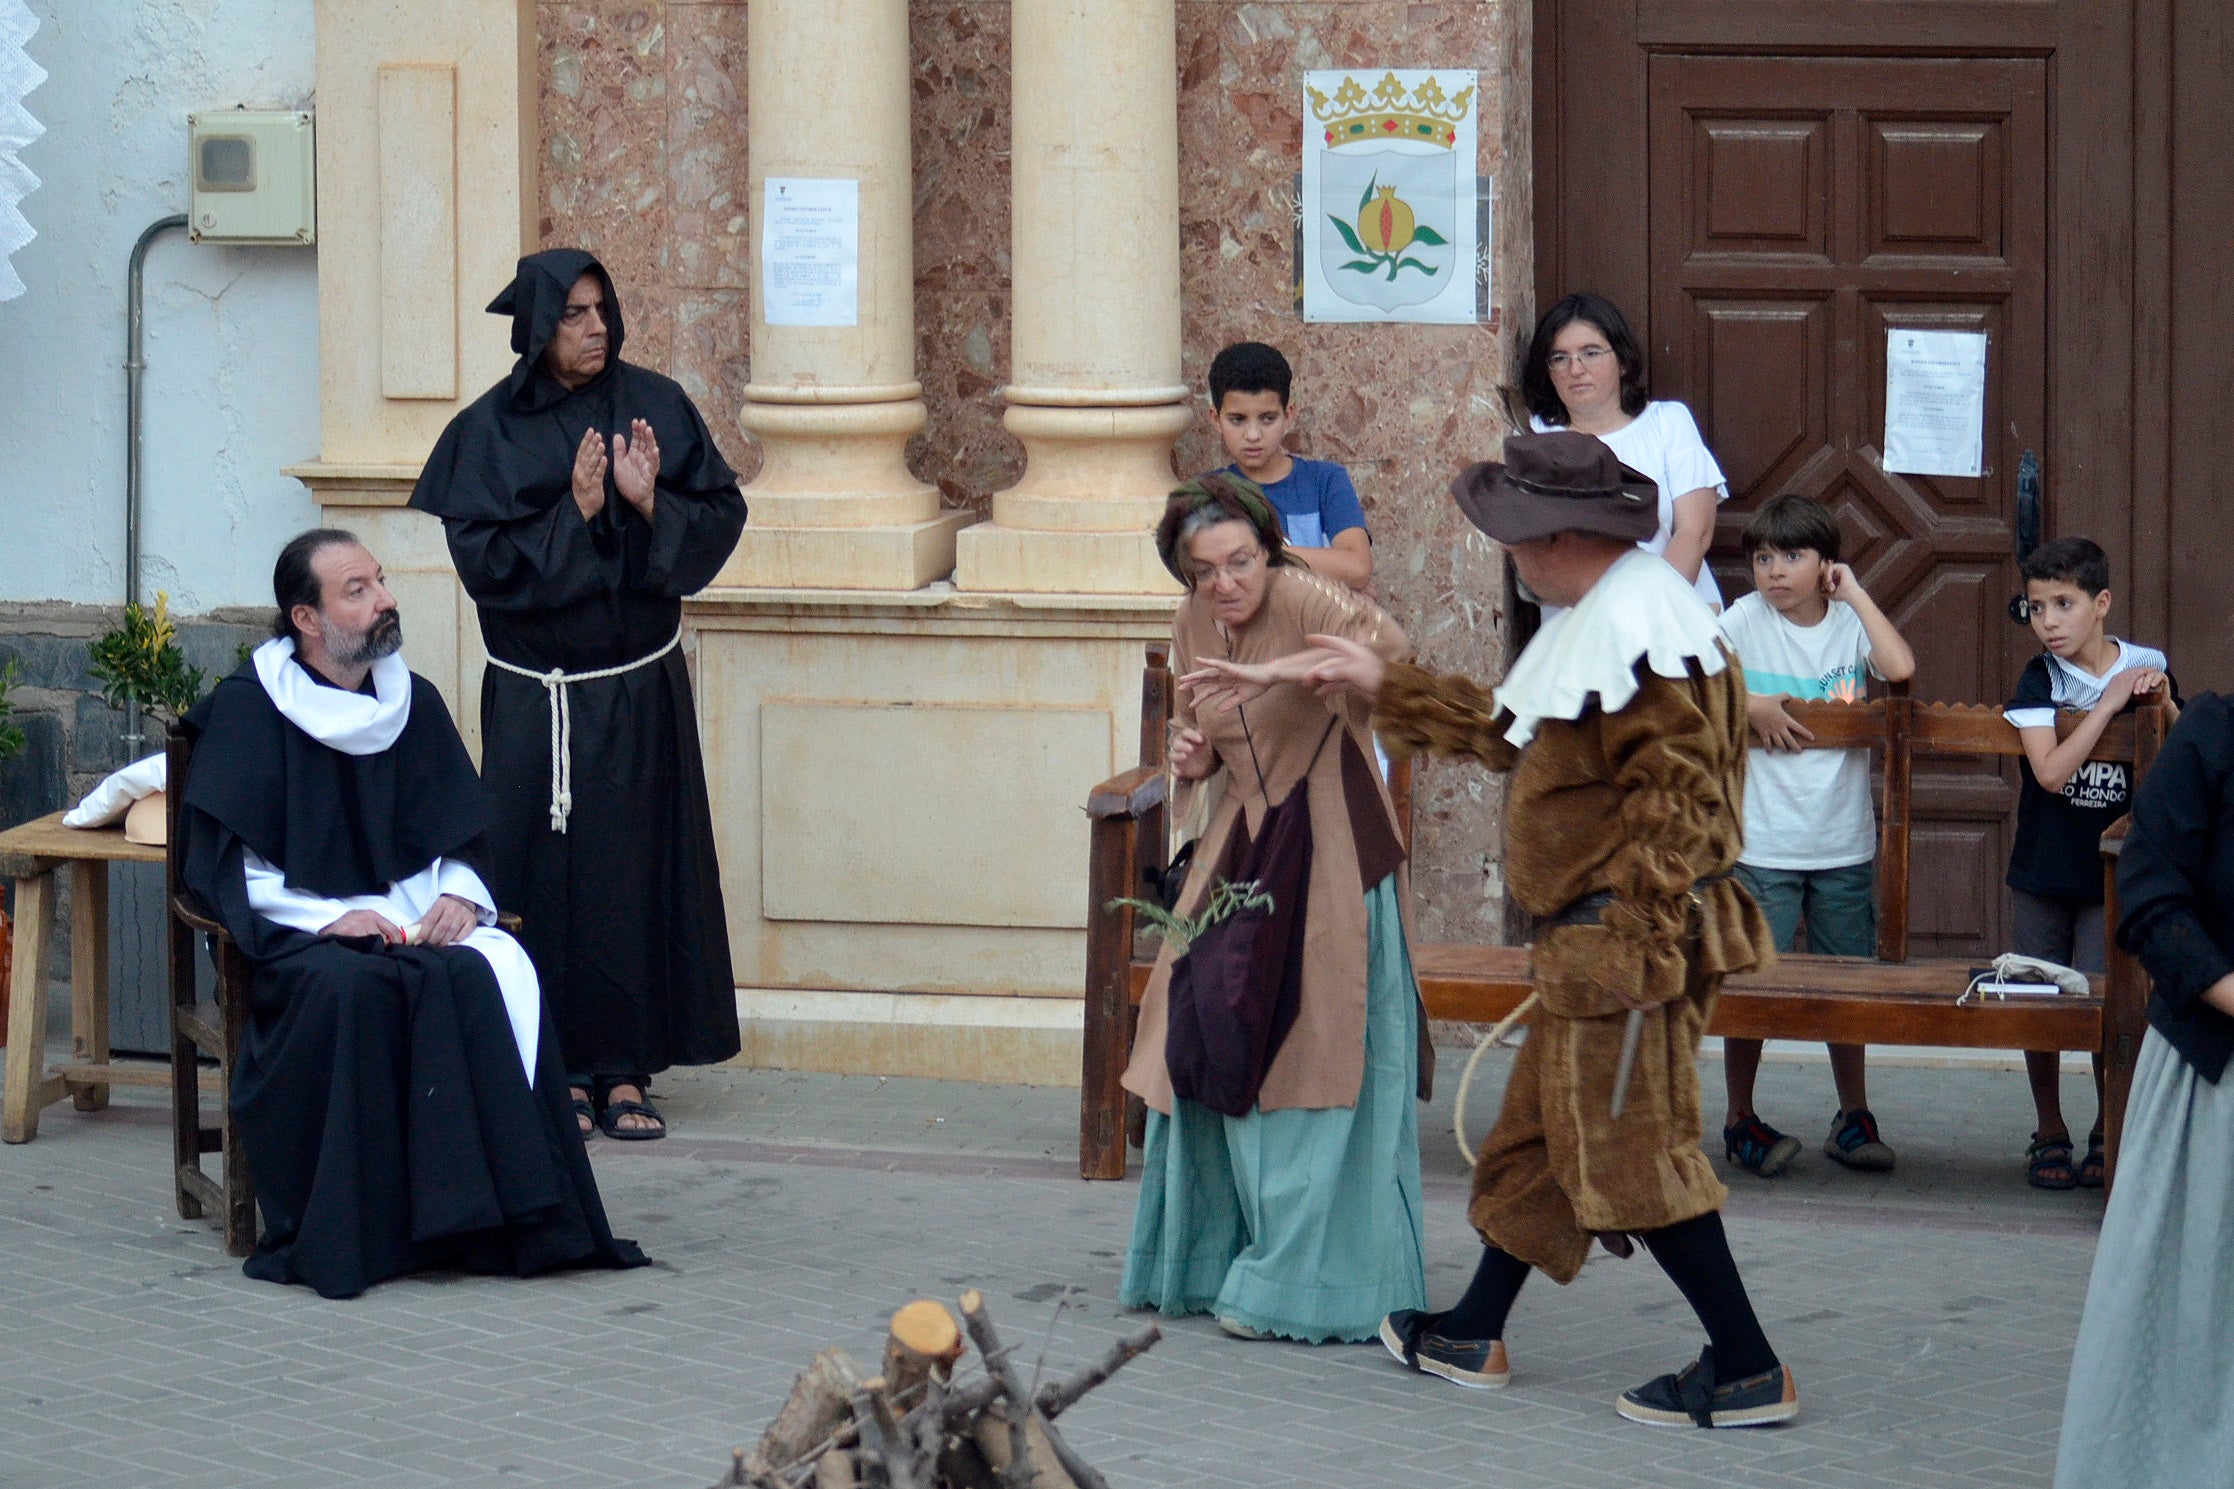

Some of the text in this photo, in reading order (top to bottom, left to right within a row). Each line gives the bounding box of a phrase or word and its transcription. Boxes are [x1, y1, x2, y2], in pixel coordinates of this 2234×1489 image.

[1819, 666, 1845, 692] SUNSET
[2067, 762, 2126, 789] MPA
[2070, 797, 2107, 808] FERREIRA
[2079, 786, 2126, 802] HONDO
